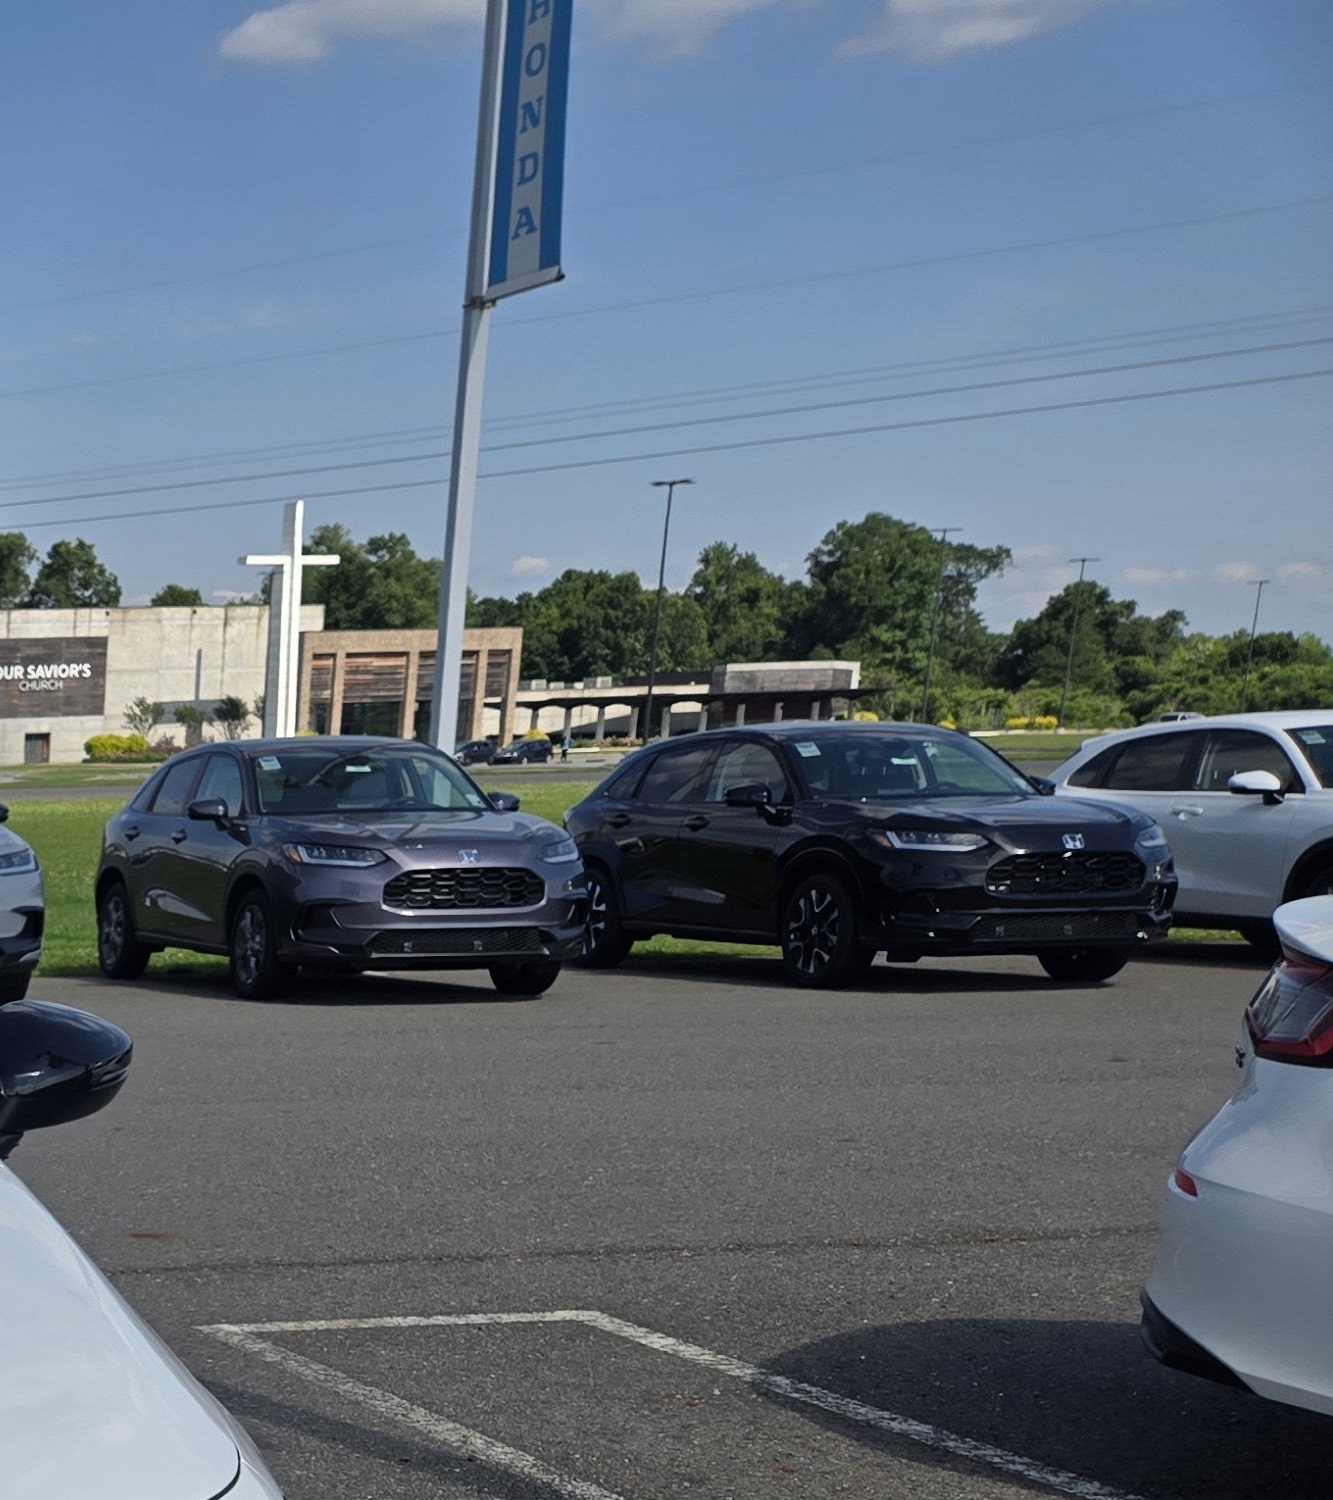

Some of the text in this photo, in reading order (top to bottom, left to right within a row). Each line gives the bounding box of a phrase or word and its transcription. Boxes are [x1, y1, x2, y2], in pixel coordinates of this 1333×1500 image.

[512, 0, 550, 239] HONDA
[27, 663, 92, 678] SAVIOR'S
[19, 680, 64, 691] CHURCH
